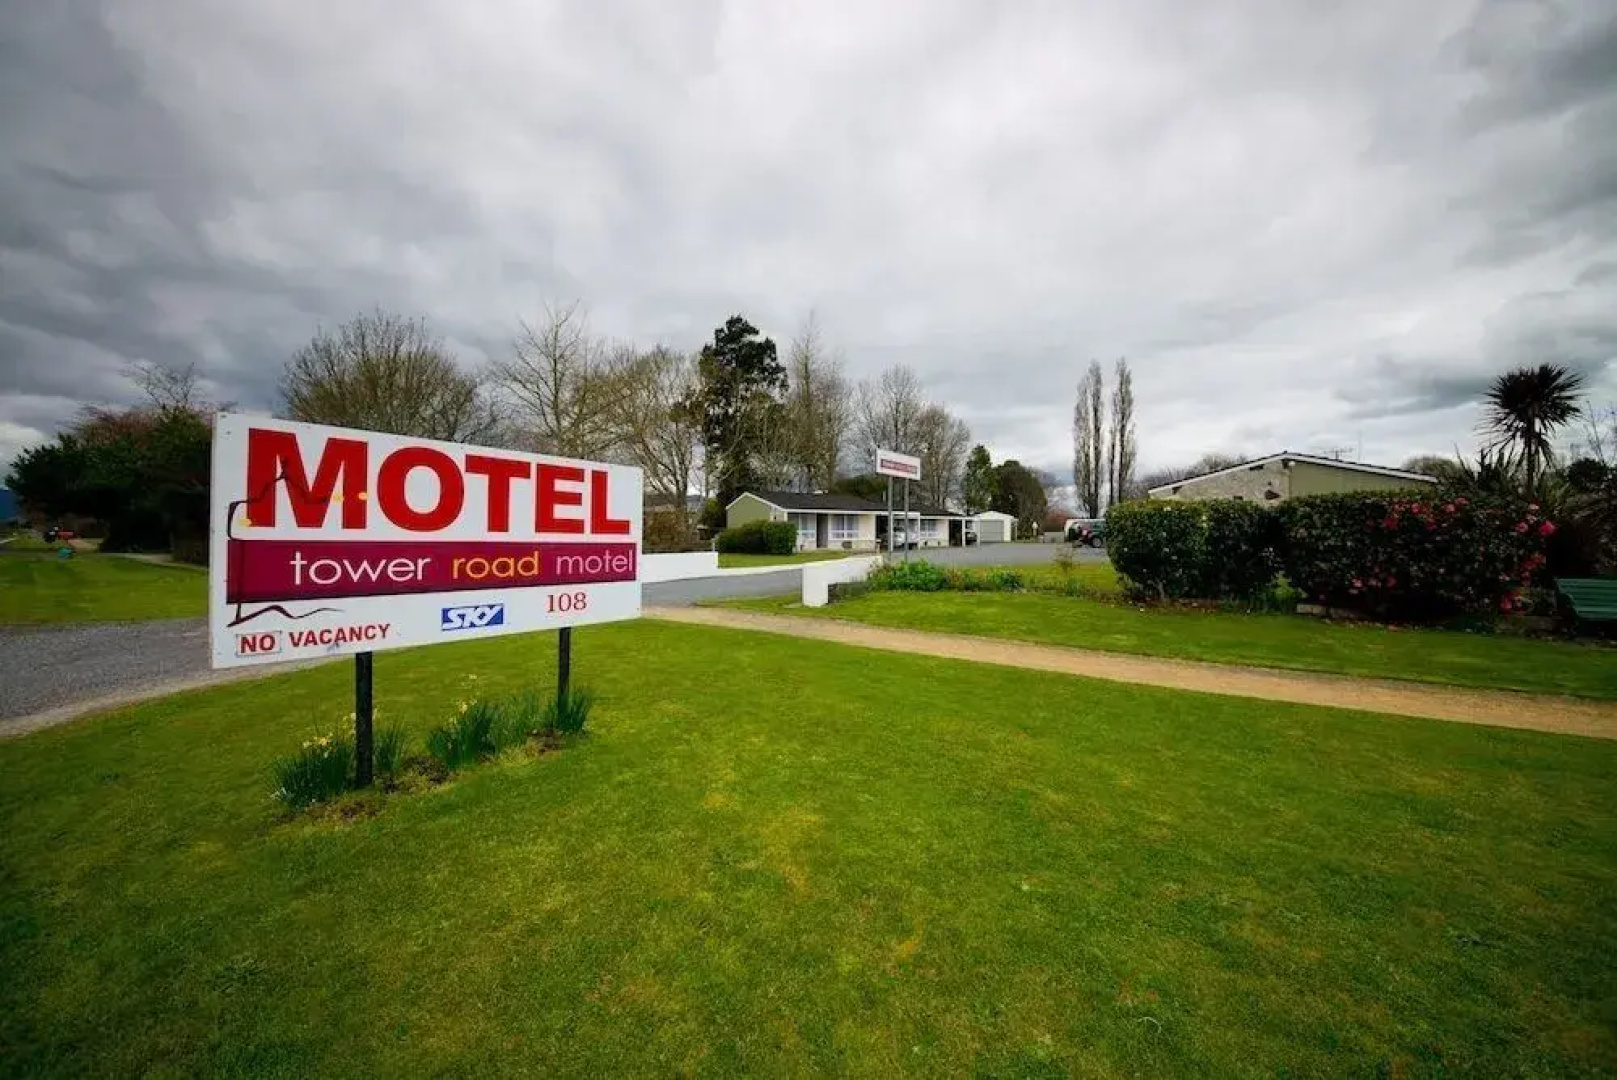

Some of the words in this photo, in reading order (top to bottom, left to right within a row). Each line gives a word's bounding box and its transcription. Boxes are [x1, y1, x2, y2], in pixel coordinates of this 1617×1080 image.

[247, 427, 630, 534] MOTEL
[290, 551, 431, 586] tower
[452, 551, 539, 579] road
[555, 549, 634, 577] motel
[442, 604, 503, 631] SKY
[546, 592, 588, 613] 108
[240, 634, 276, 653] NO
[289, 623, 391, 648] VACANCY
